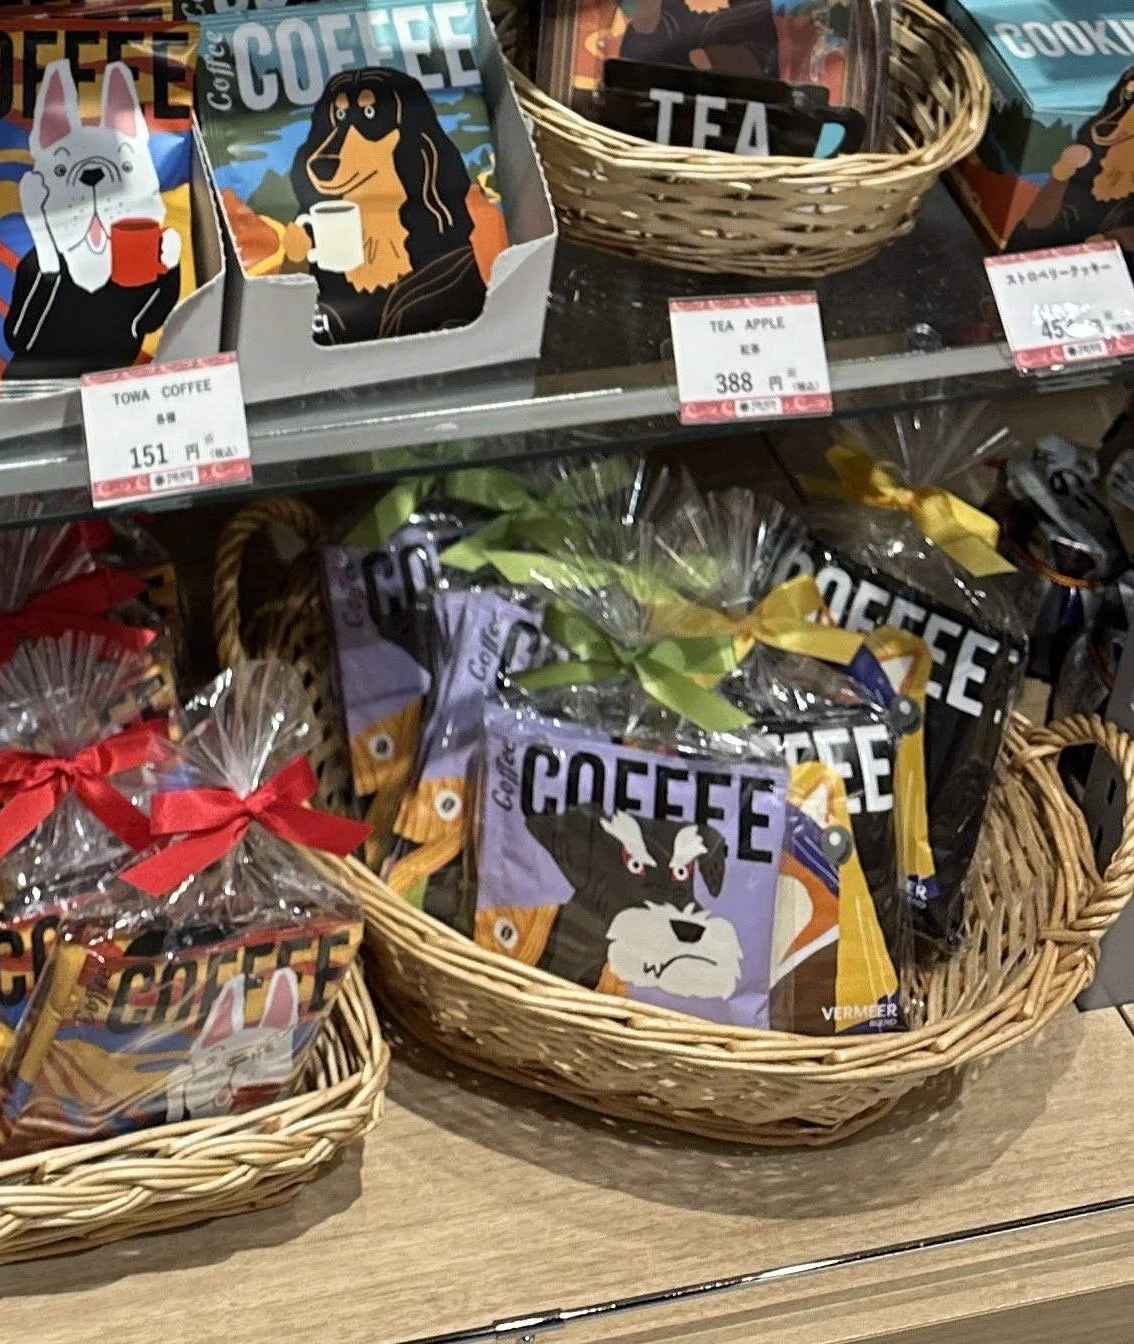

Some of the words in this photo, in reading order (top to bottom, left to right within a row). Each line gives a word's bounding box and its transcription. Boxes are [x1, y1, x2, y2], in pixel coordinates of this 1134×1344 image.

[207, 29, 233, 113] Coffee
[233, 1, 479, 111] COFFEE
[649, 88, 771, 157] TEA
[710, 320, 734, 333] TEA
[745, 317, 785, 330] APPLE
[112, 389, 150, 406] TOWA
[161, 378, 212, 399] COFFEE
[716, 372, 753, 394] 388
[129, 442, 169, 469] 151
[491, 739, 518, 812] Coffee
[521, 745, 775, 863] COFFEE
[821, 1003, 899, 1021] VERMEER
